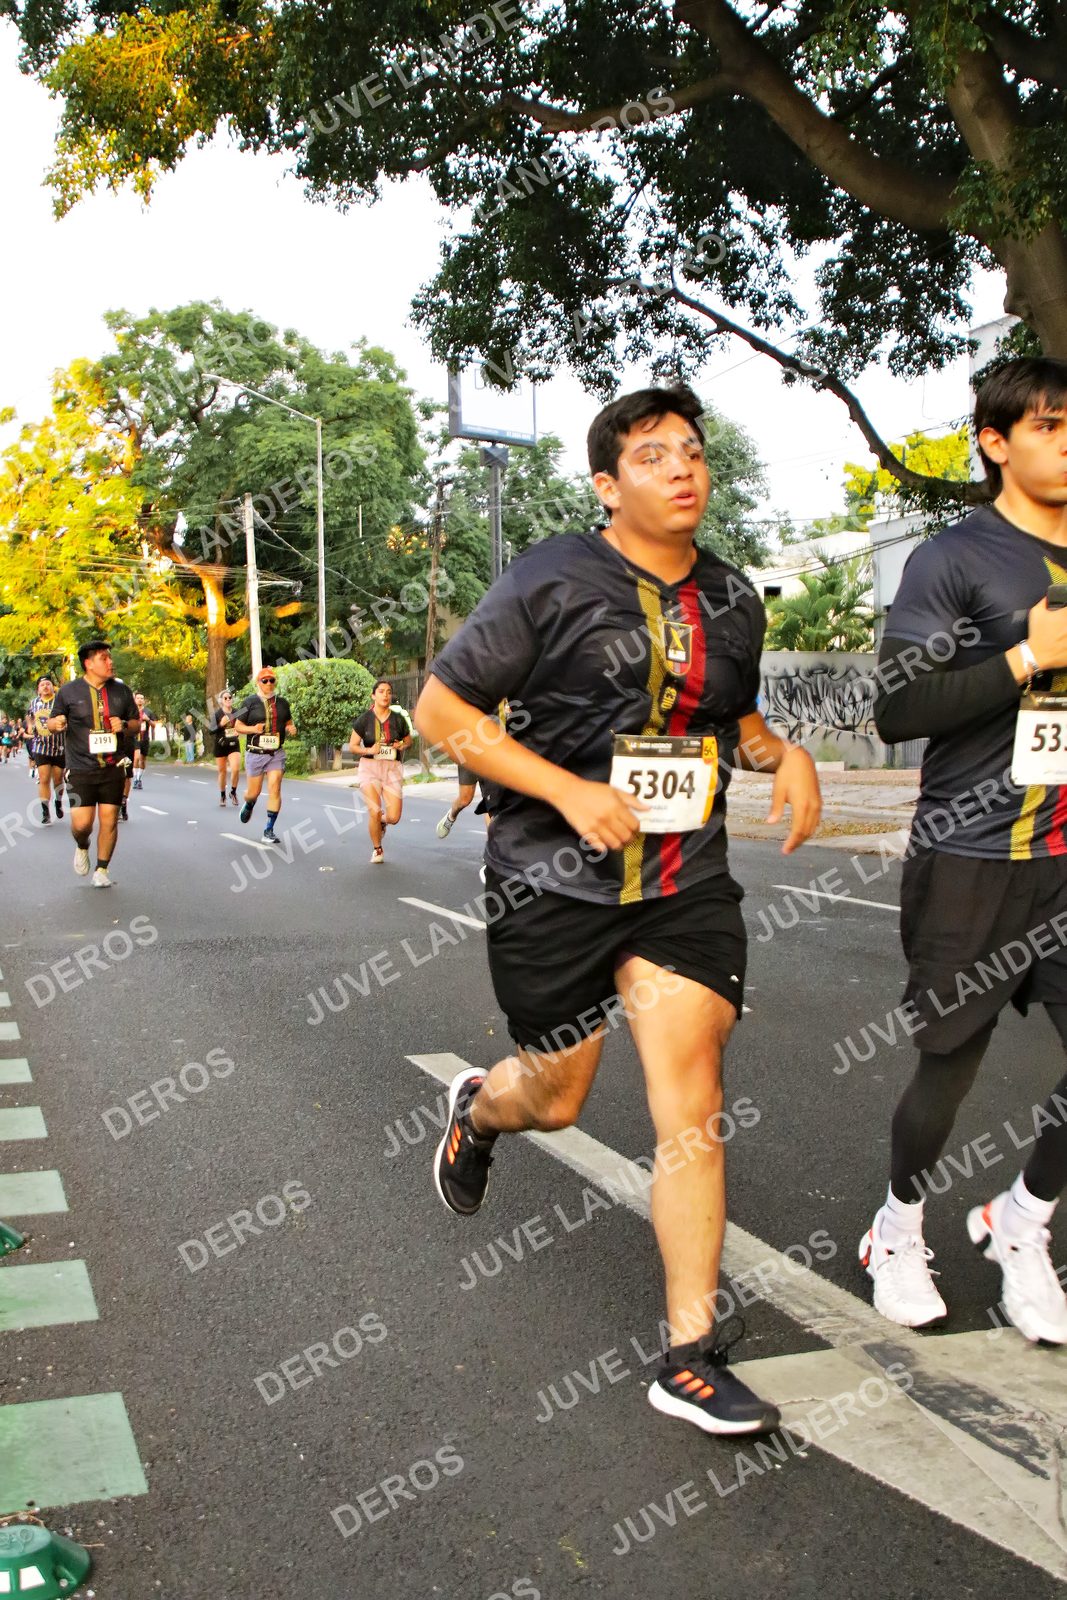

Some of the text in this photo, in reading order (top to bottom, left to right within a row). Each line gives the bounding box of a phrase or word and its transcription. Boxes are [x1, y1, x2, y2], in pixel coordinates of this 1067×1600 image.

[94, 736, 112, 745] 2191
[1031, 723, 1067, 752] 53
[628, 769, 696, 800] 5304
